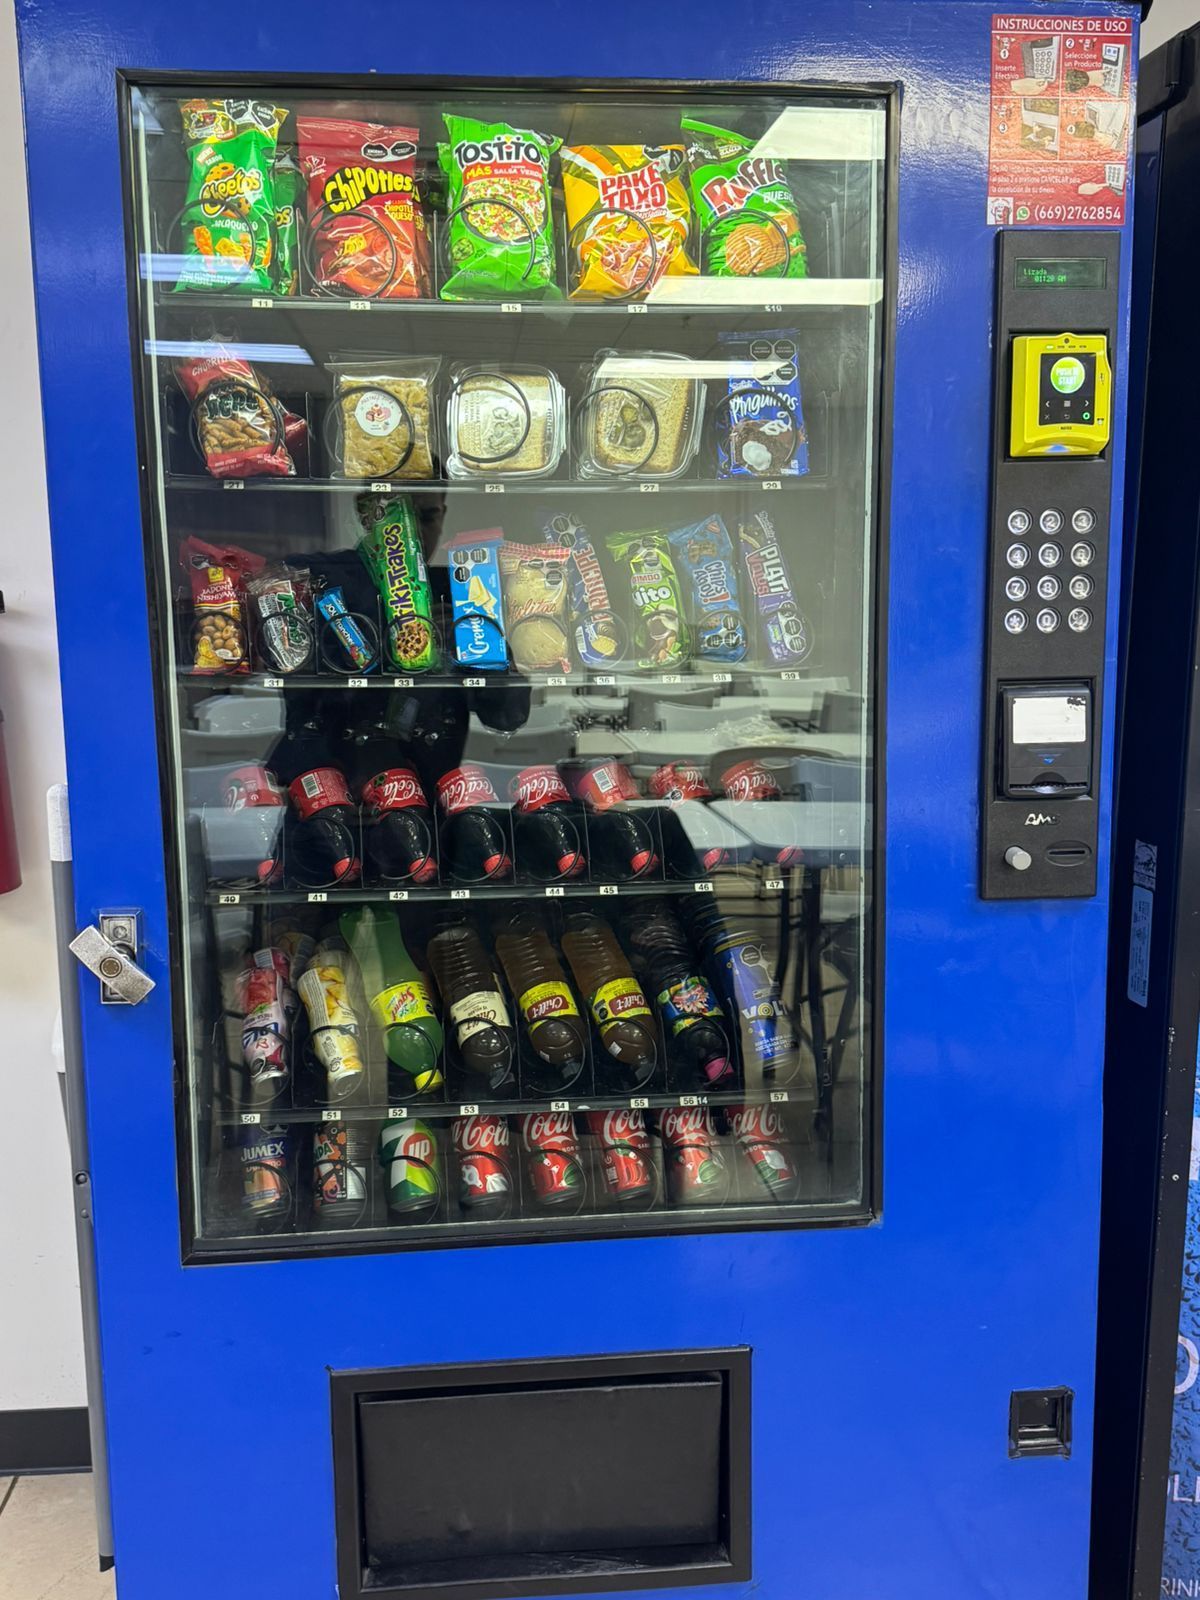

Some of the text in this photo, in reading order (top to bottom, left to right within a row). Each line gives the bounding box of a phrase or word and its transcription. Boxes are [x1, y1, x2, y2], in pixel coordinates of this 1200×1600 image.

[997, 18, 1127, 32] INSTRUCCIONES DE USO
[1067, 39, 1073, 47] 2
[995, 64, 1016, 72] Inserte
[995, 72, 1019, 80] Efectivo
[466, 165, 492, 180] MÁS
[600, 162, 663, 195] PAKE
[603, 183, 667, 216] TAXO
[1035, 205, 1121, 221] (669)2762854
[704, 561, 727, 595] Chips
[398, 679, 410, 687] 33
[532, 996, 563, 1018] Chill-t
[616, 994, 645, 1010] Chill-t
[683, 1097, 694, 1105] 56
[698, 1096, 708, 1104] 14
[243, 1115, 255, 1123] 50
[327, 1111, 337, 1119] 51
[241, 1141, 284, 1161] JUMEX
